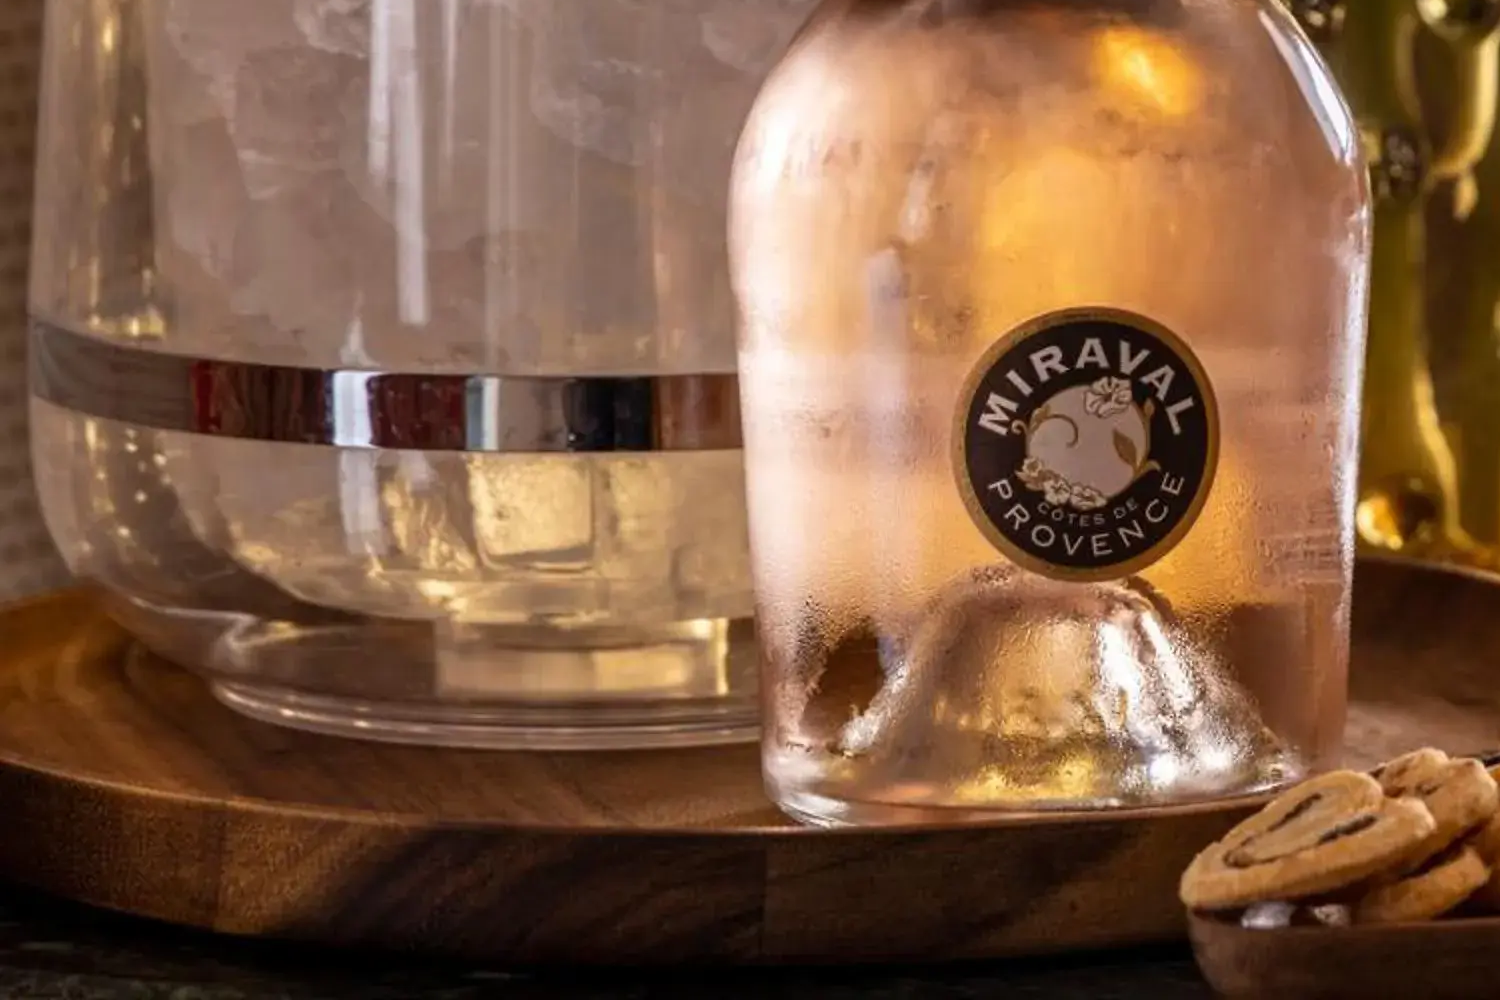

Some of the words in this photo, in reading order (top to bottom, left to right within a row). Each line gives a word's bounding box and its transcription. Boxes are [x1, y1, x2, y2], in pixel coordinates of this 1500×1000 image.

[977, 337, 1195, 437] MIRAVAL
[987, 471, 1185, 557] PROVENCE
[1113, 497, 1139, 519] DE
